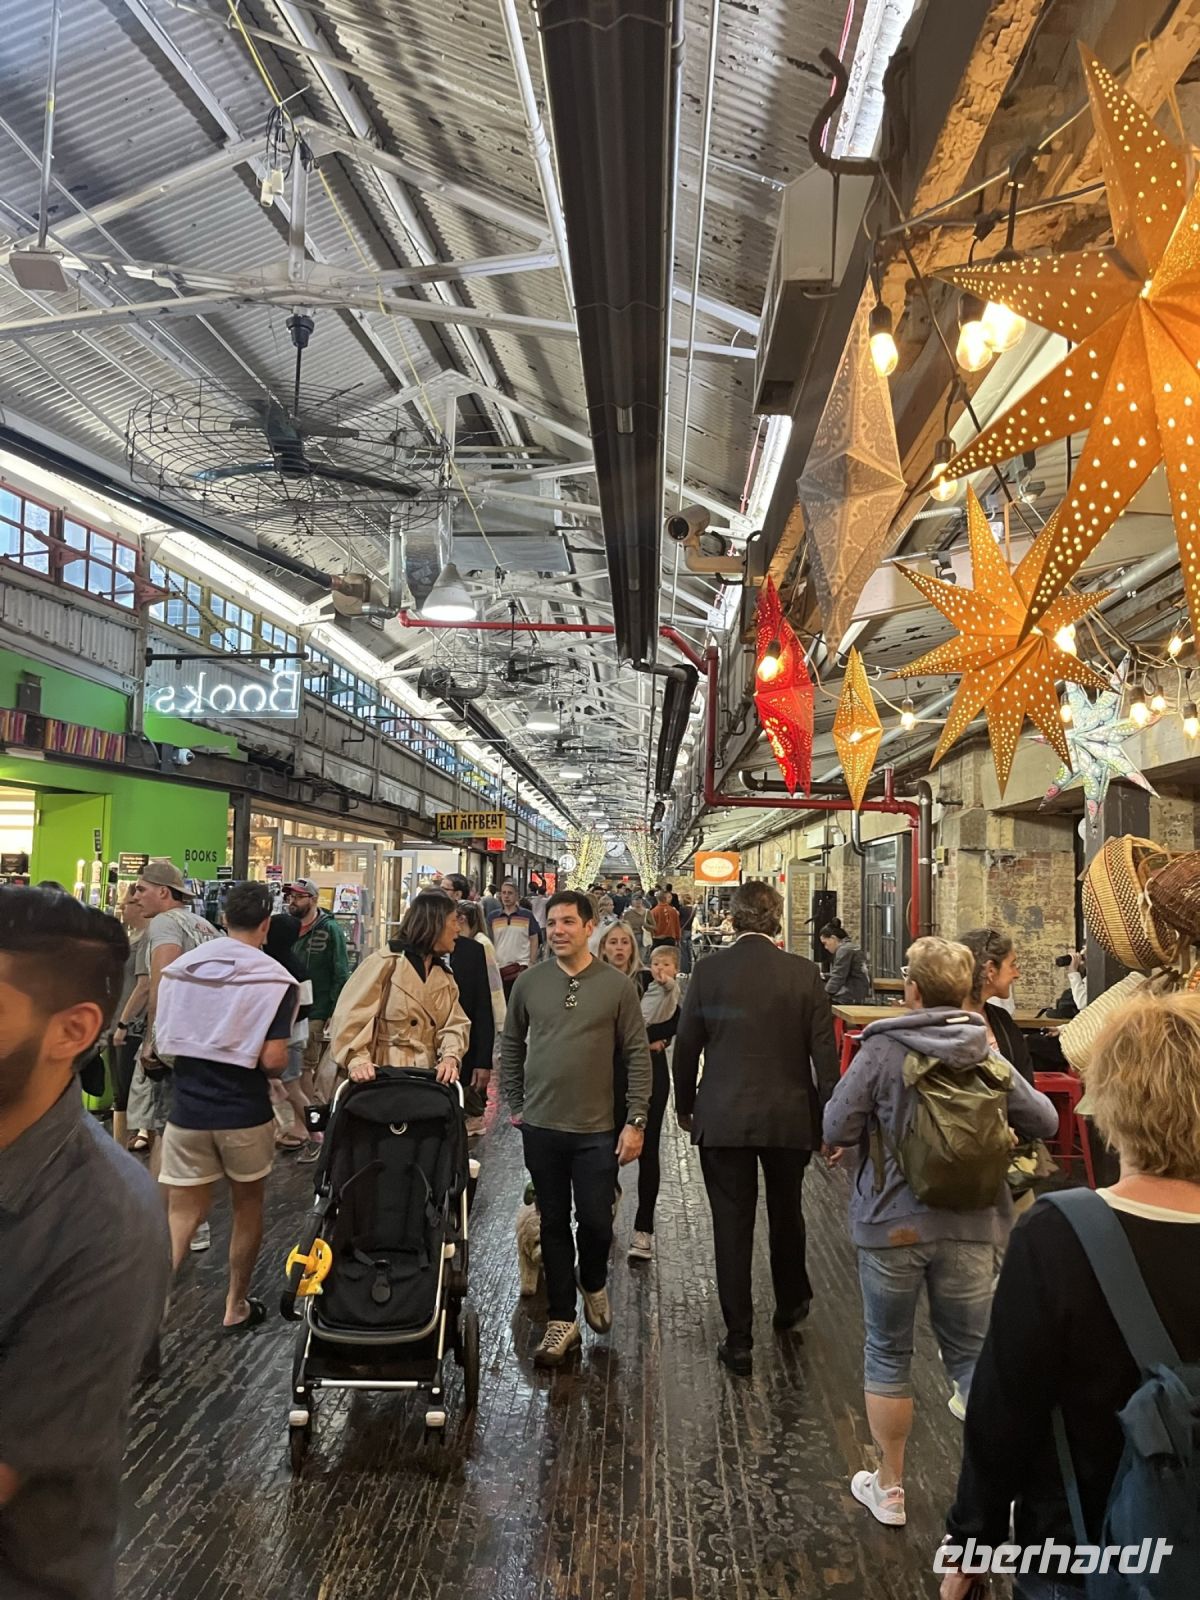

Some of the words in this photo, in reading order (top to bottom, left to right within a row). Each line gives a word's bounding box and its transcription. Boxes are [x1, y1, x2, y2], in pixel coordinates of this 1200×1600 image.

[440, 815, 458, 830] EAT
[461, 813, 504, 830] OFFBEAT
[185, 849, 218, 863] BOOKS
